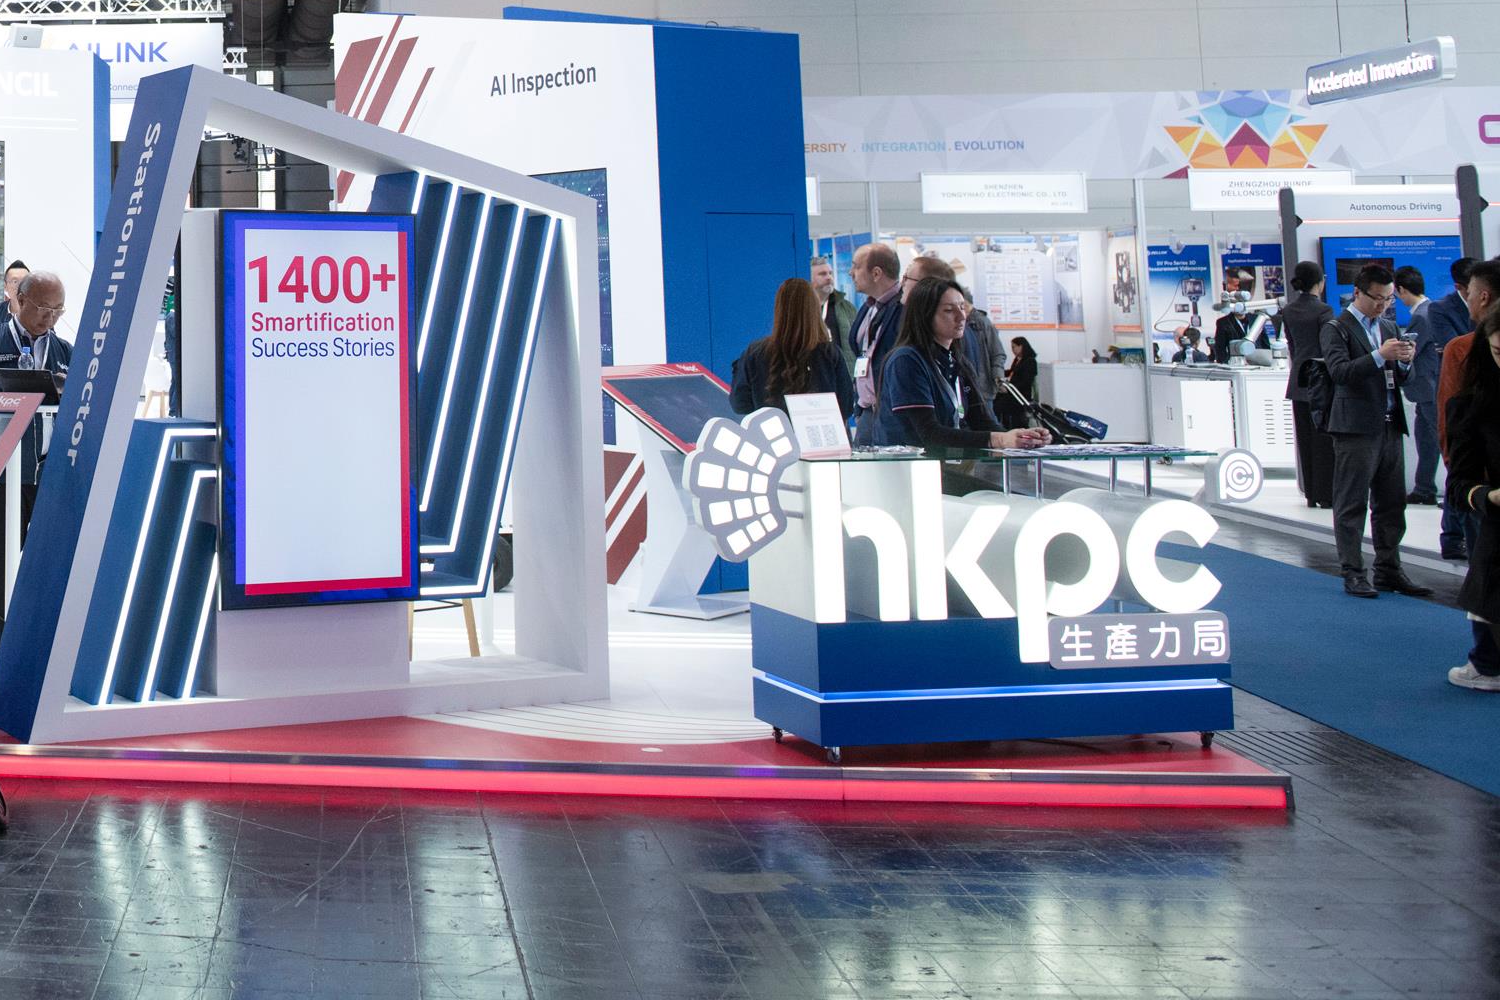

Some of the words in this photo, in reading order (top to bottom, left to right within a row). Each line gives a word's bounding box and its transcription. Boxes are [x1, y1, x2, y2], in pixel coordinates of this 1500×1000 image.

[490, 73, 507, 97] AI
[511, 63, 597, 98] Inspection
[1308, 63, 1368, 96] Accelerated
[1370, 51, 1436, 82] Innovation
[861, 141, 946, 153] INTEGRATION
[954, 140, 1025, 151] EVOLUTION
[1221, 189, 1279, 197] DELLONSCOP
[1349, 203, 1407, 212] Autonomous
[1409, 202, 1443, 213] Driving
[66, 121, 161, 470] StationInspector
[247, 255, 397, 304] 1400+
[251, 311, 395, 333] Smartification
[252, 337, 329, 358] Success
[333, 337, 395, 358] Stories
[811, 461, 1222, 663] hkpc
[1059, 619, 1228, 662] 生產力局
